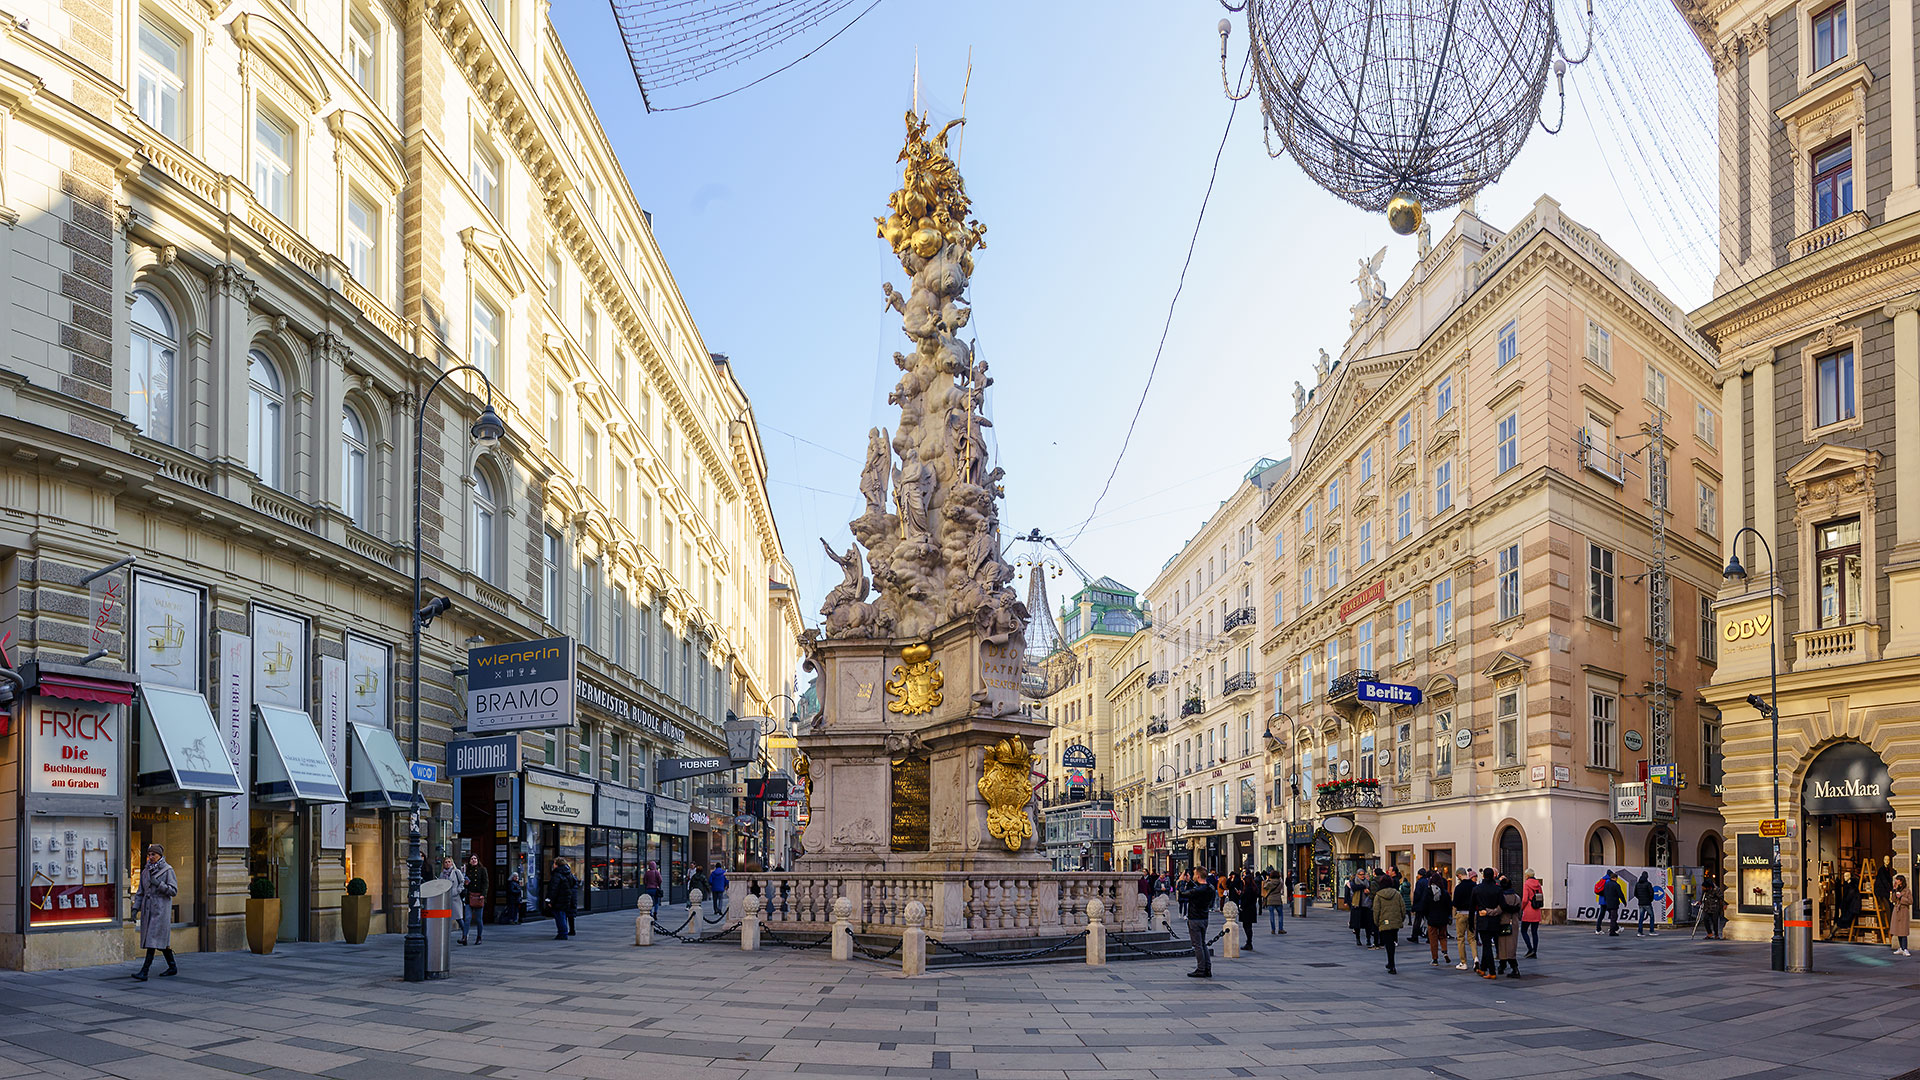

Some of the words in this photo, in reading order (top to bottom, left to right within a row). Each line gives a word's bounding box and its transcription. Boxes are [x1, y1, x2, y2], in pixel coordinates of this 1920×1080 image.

[477, 647, 559, 667] wienerin
[989, 644, 1018, 659] DEO
[984, 662, 1019, 676] PATRI
[1366, 684, 1412, 701] Berlitz
[476, 687, 559, 714] BRAMO
[479, 713, 556, 725] COIFFEUR
[62, 745, 89, 760] Die
[44, 763, 107, 777] Buchhandlung
[51, 780, 66, 788] am
[67, 779, 99, 789] Graben
[707, 786, 738, 794] swatch
[1814, 779, 1880, 799] MaxMara
[1742, 856, 1769, 865] MaxMara
